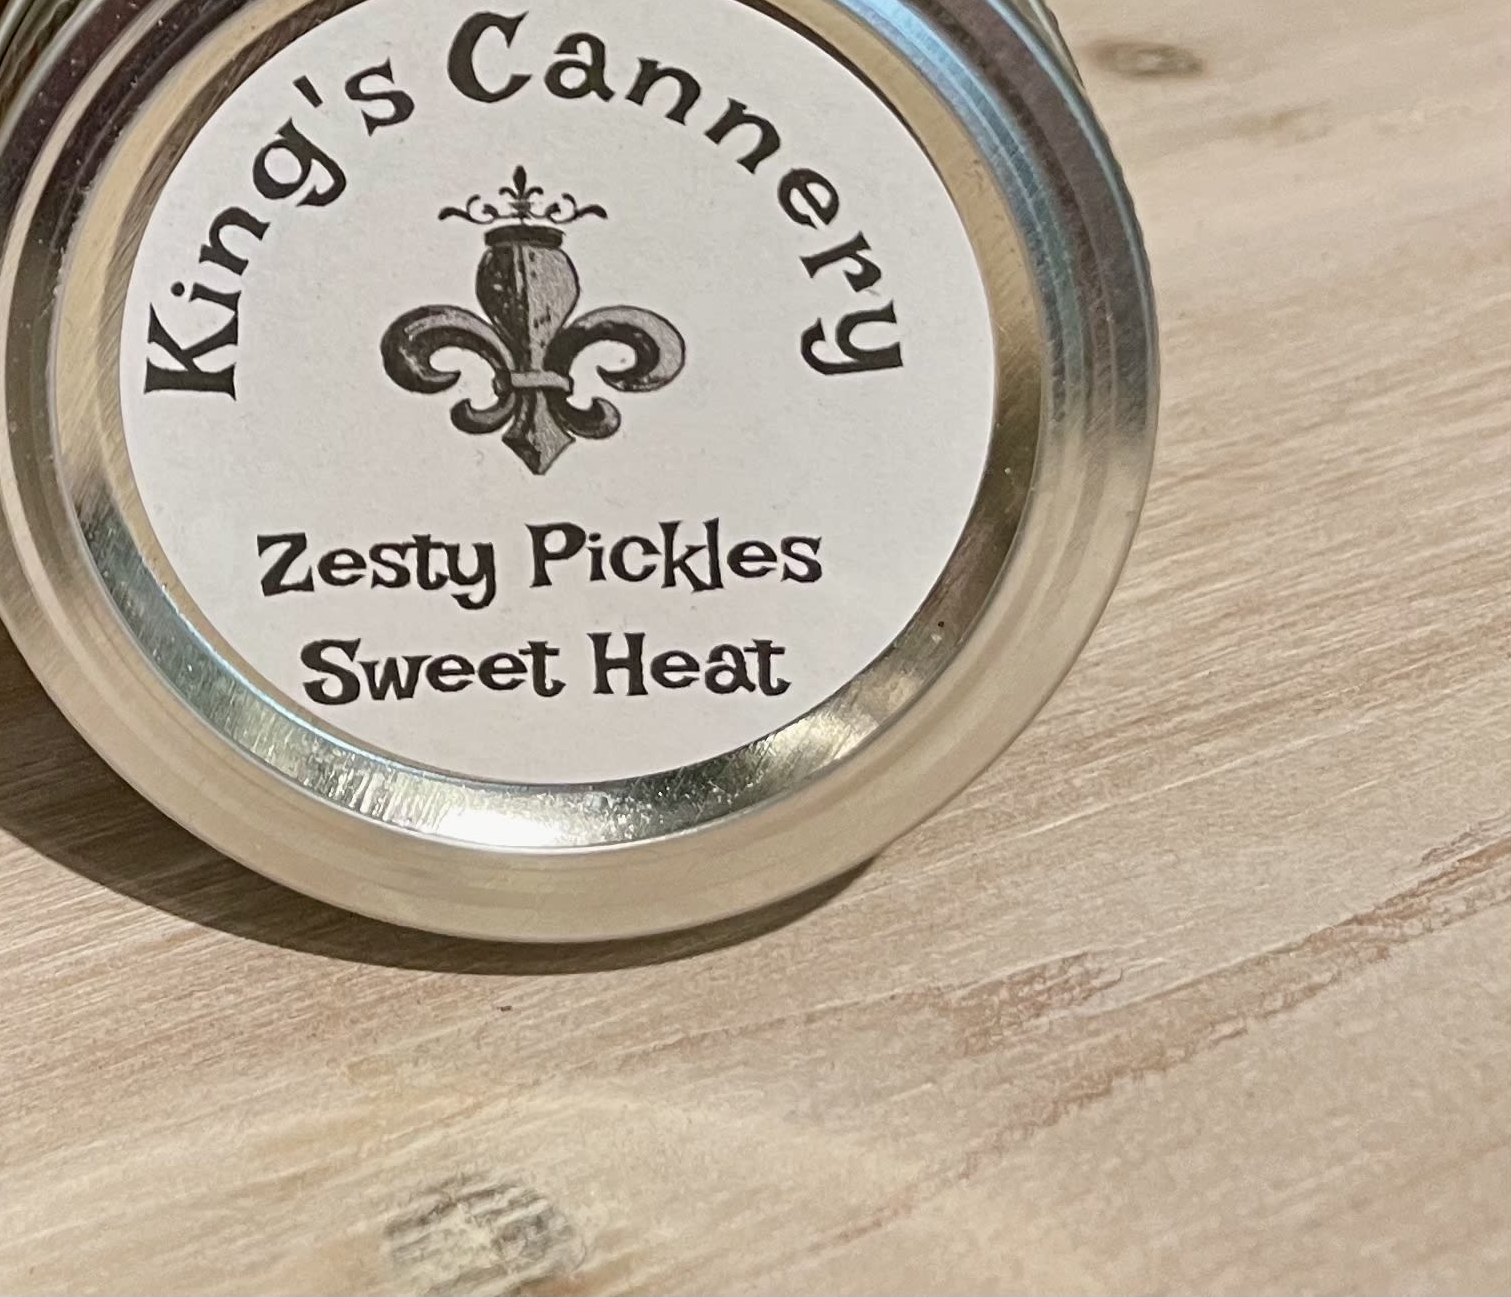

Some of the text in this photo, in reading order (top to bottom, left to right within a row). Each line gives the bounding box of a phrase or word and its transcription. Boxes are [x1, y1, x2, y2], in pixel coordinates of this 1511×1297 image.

[145, 11, 904, 400] King's Cannery
[257, 518, 823, 610] Zesty Pickles
[301, 633, 791, 705] Sweet Heat
